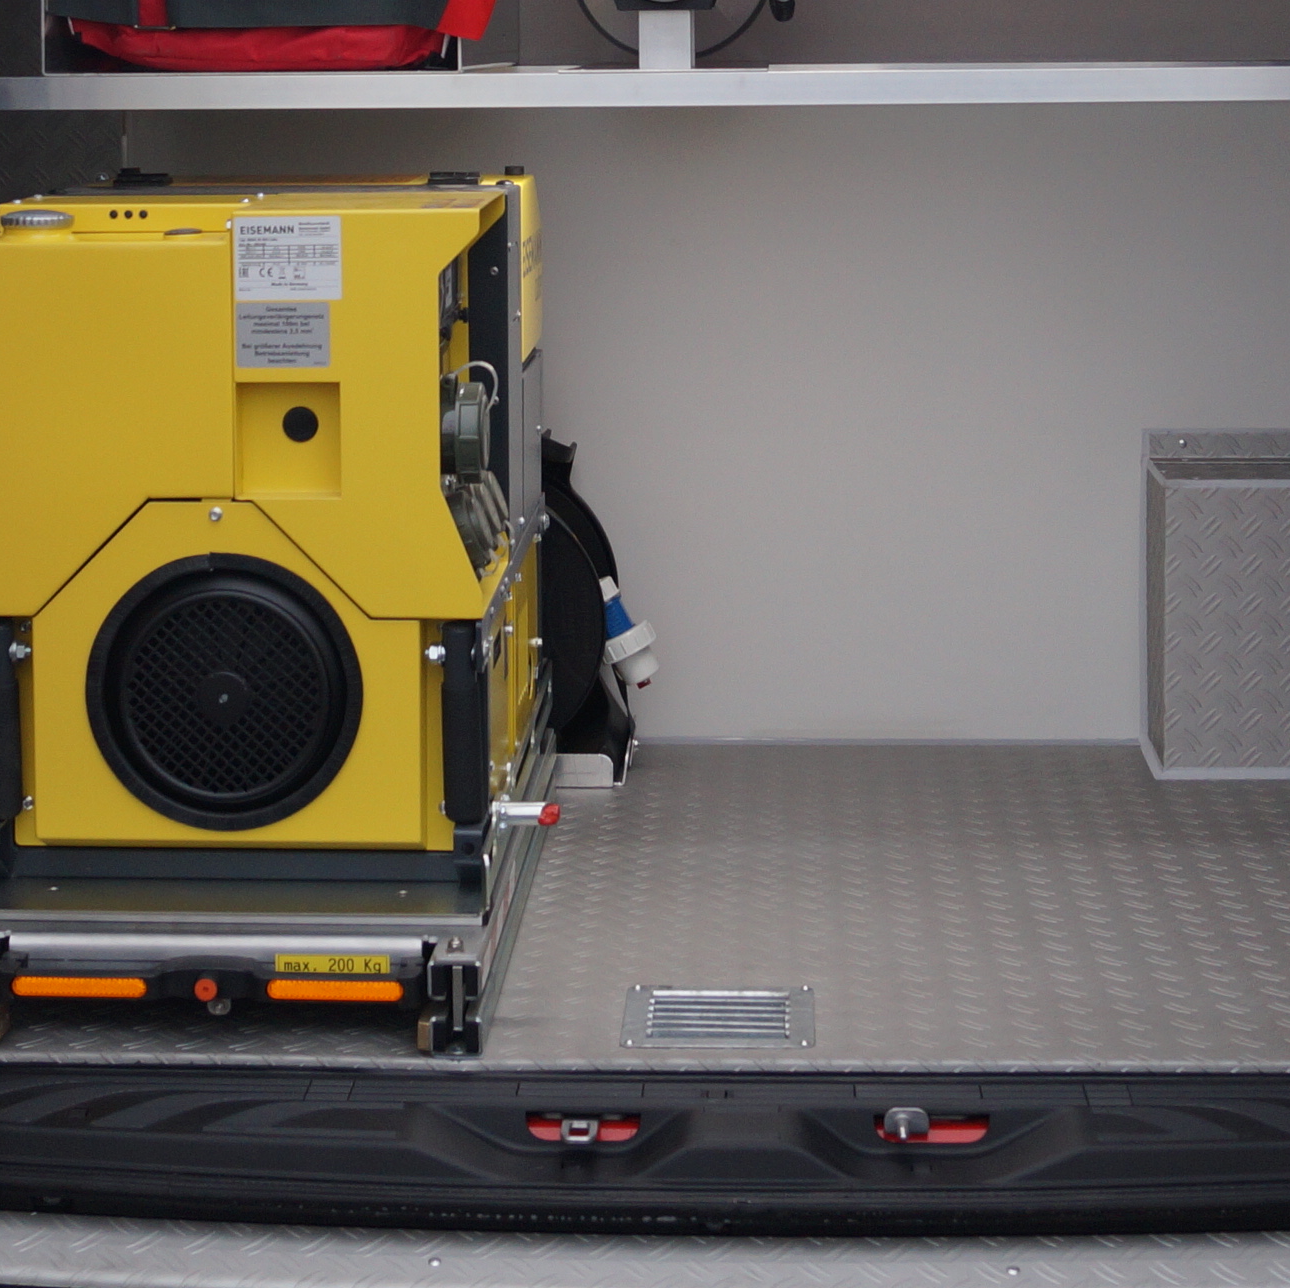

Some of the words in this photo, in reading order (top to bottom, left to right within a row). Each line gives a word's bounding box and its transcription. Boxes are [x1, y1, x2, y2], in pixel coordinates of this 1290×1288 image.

[240, 225, 294, 235] EISEMANN
[283, 961, 318, 973] max.
[327, 957, 355, 973] 200
[363, 958, 382, 974] Kg
